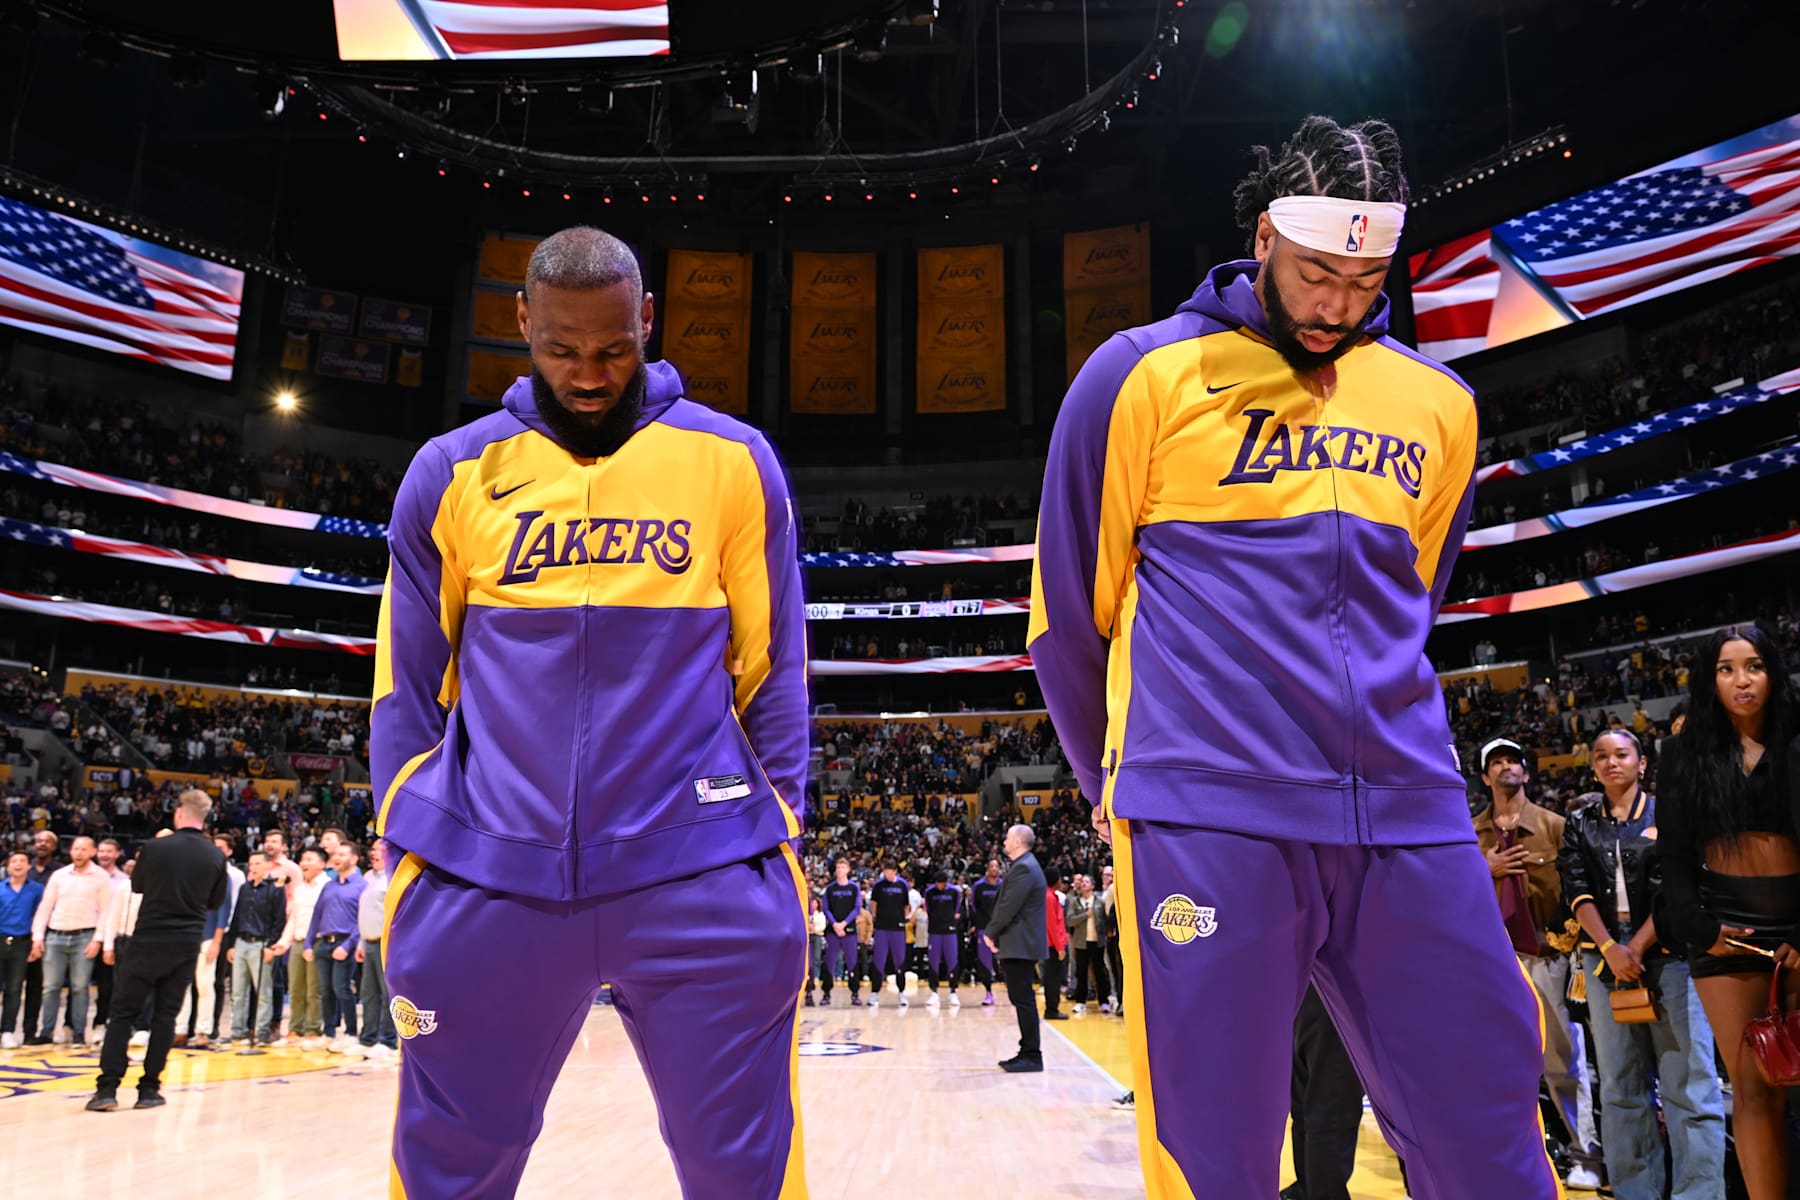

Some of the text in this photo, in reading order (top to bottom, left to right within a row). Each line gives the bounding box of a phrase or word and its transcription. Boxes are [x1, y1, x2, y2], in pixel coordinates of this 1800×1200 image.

[1218, 409, 1426, 499] LAKERS
[497, 510, 692, 586] LAKERS
[1023, 796, 1039, 805] 107
[1151, 906, 1214, 934] LAKERS
